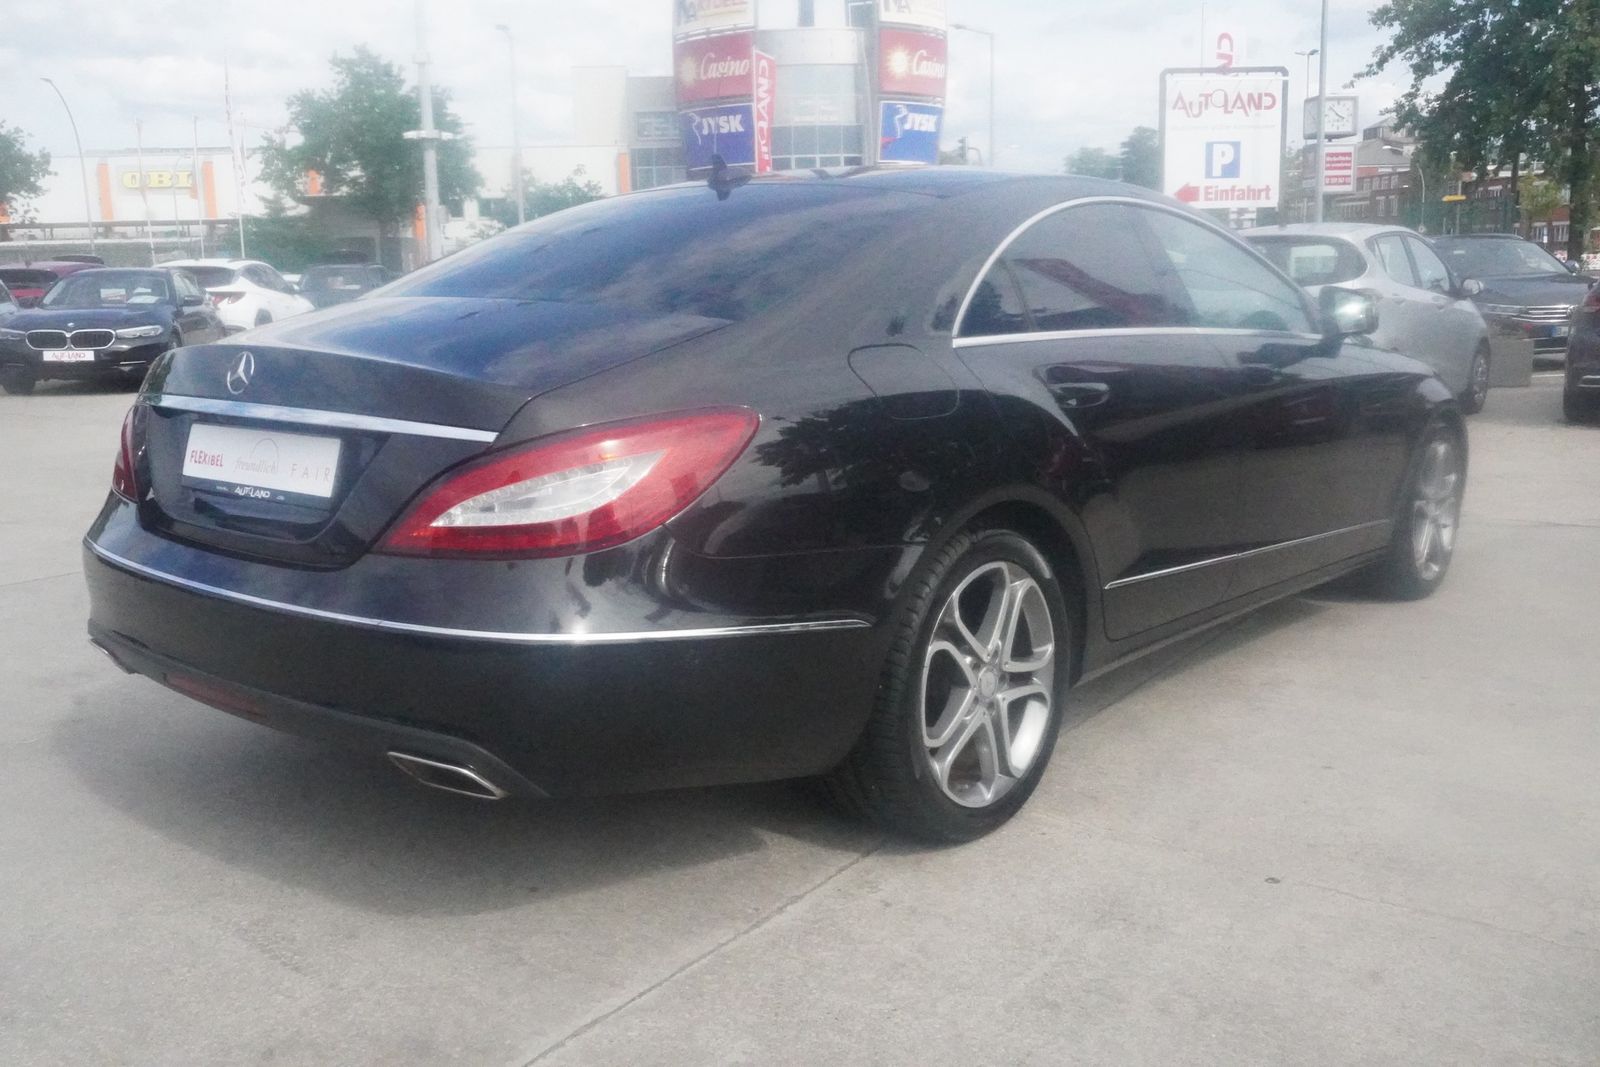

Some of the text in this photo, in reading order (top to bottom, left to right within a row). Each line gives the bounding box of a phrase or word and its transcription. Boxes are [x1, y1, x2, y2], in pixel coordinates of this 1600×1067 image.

[700, 52, 750, 81] Casino
[912, 50, 945, 80] Casino
[1172, 89, 1277, 118] AUTOLAND
[702, 114, 744, 135] JYSK
[904, 111, 938, 133] JYSK
[1212, 143, 1234, 177] P
[122, 171, 192, 189] OBI
[1204, 185, 1271, 201] Einfahrt
